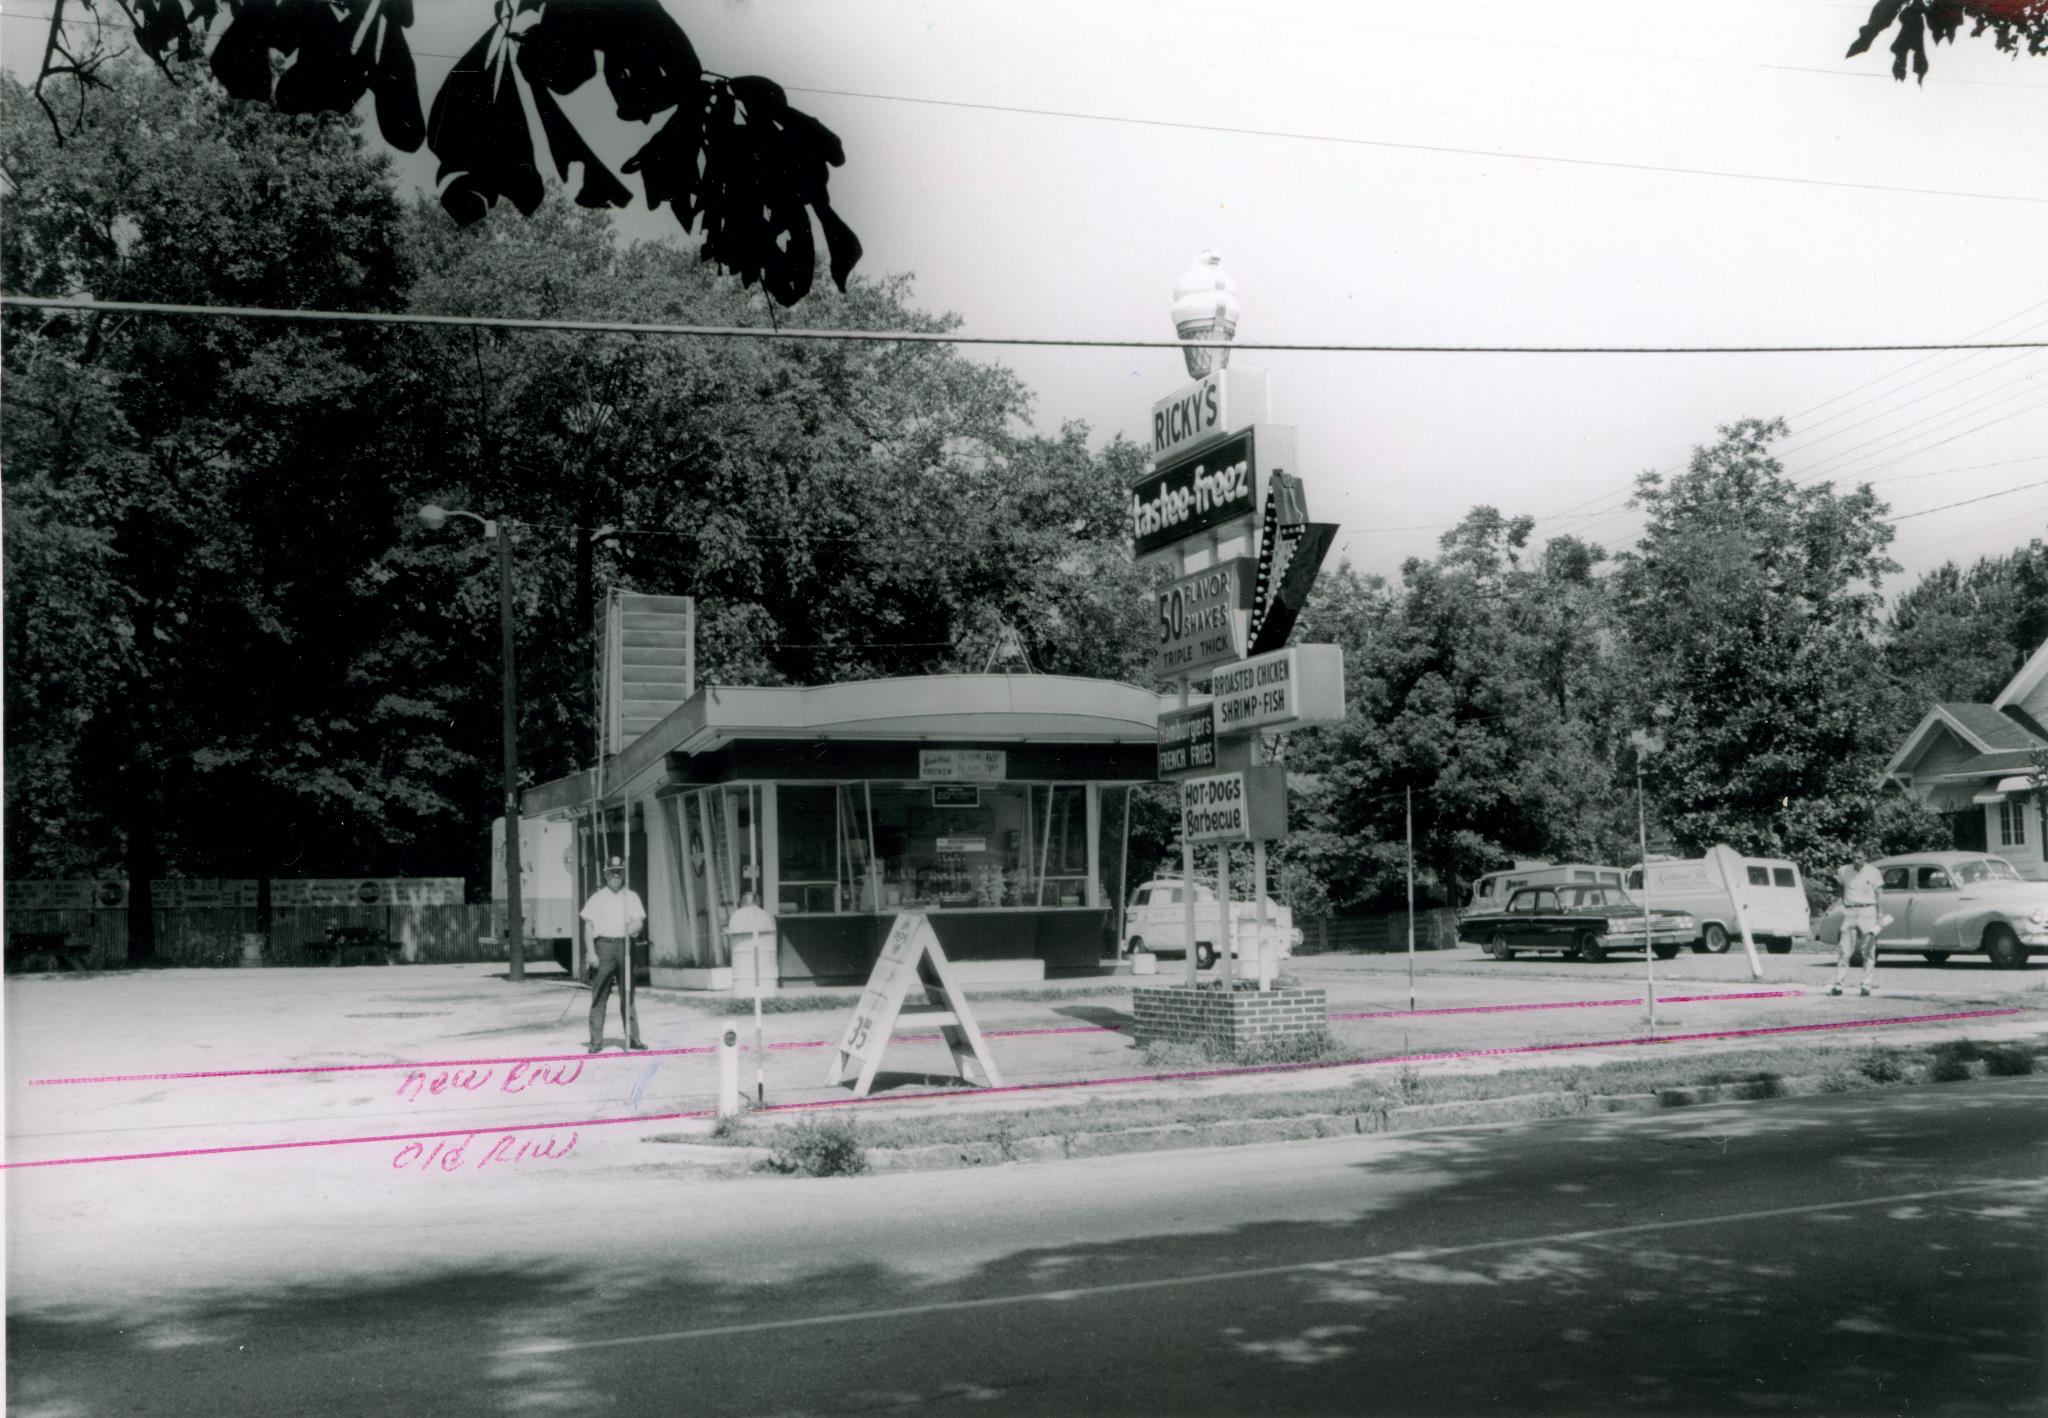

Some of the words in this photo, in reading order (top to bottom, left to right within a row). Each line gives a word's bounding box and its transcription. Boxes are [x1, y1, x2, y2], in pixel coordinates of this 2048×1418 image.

[1154, 379, 1218, 453] RICKY'S
[1132, 460, 1248, 539] tastee-freez
[1159, 588, 1185, 644] 50
[1184, 571, 1229, 604] FLAVOR
[1184, 602, 1228, 638] SHAKES
[1163, 644, 1193, 667] TRIPLE
[1200, 635, 1228, 658] THICK
[1213, 666, 1255, 697] BROASTED
[1257, 658, 1290, 688] CHICKEN
[1158, 716, 1212, 745] Hamburgers
[1159, 748, 1187, 772] FRENCH
[1189, 742, 1213, 767] FRIES
[1185, 778, 1241, 807] HOT-DOGS
[1186, 807, 1241, 837] Barbecue
